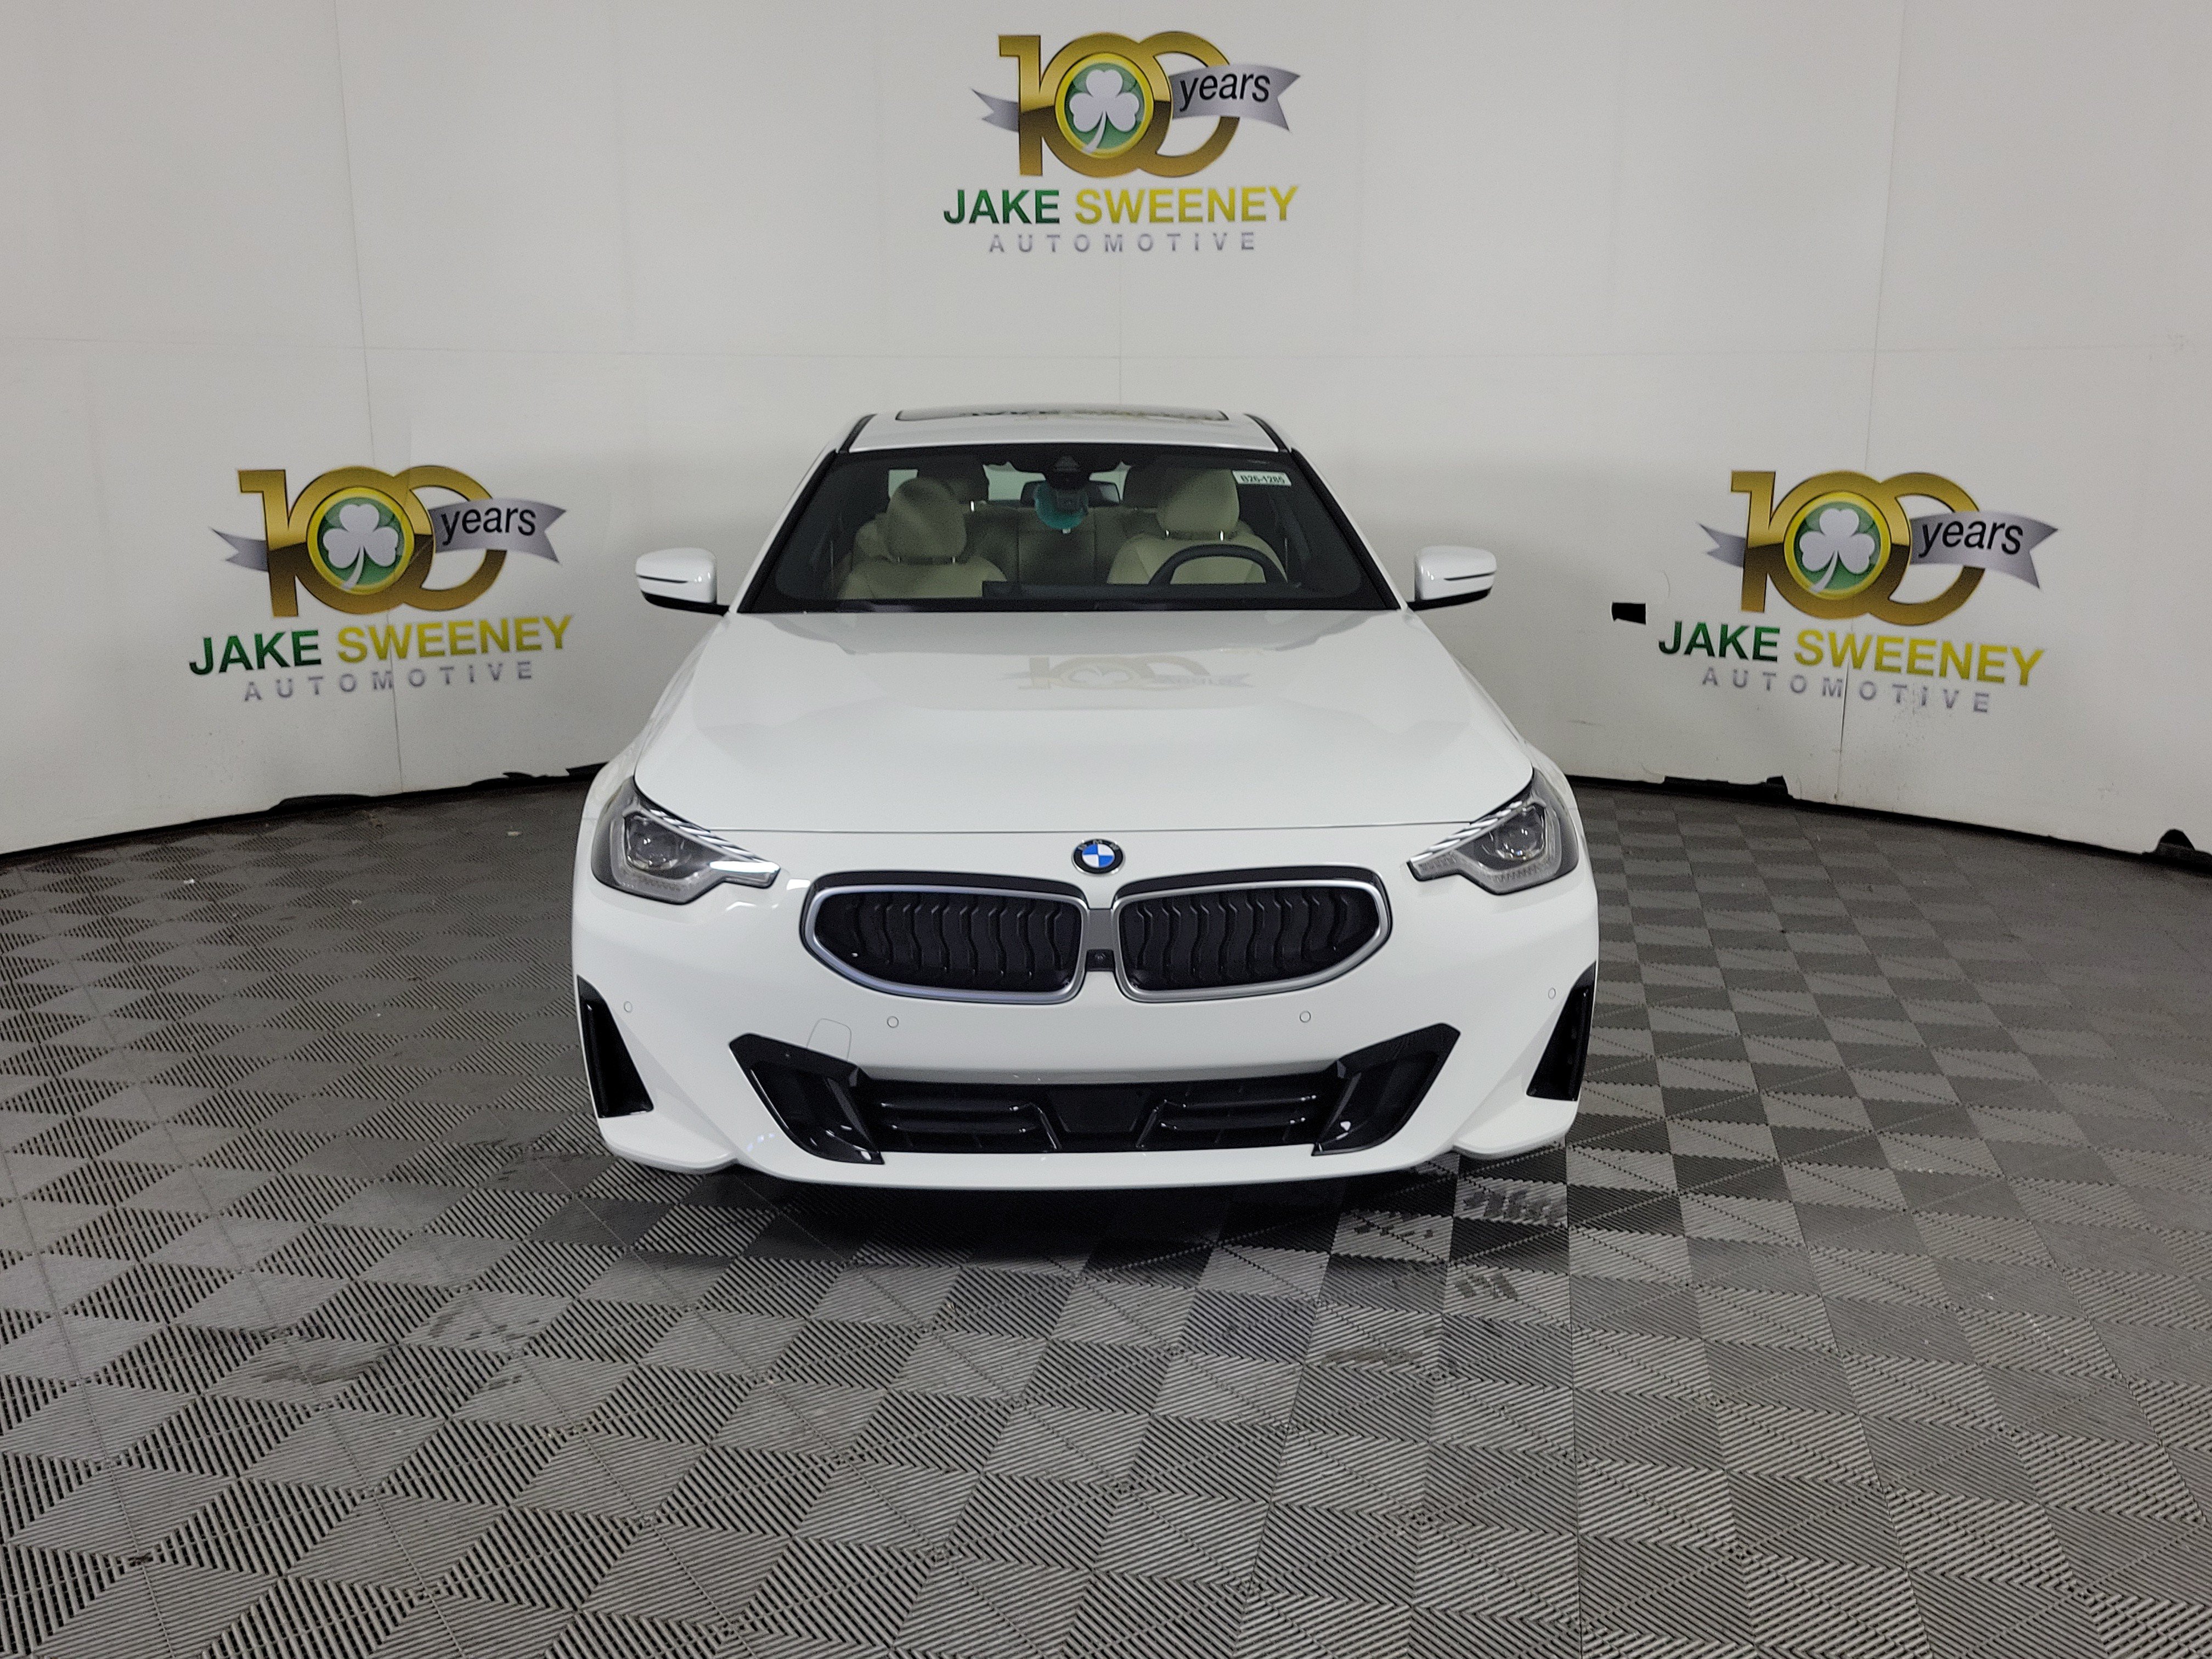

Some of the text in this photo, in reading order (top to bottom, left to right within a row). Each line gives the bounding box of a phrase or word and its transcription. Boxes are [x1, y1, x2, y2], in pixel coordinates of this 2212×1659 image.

[998, 31, 1271, 178] 100 years
[943, 185, 1299, 225] JAKE SWEENEY
[989, 231, 1255, 254] AUTOMOTIVE
[238, 465, 537, 618] 100 years
[1730, 470, 2024, 626] 100 years
[189, 614, 573, 676] JAKE SWEENEY
[1658, 620, 2045, 686] JAKE SWEENEY
[244, 662, 532, 703] AUTOMOTIVE
[1702, 666, 1990, 713] AUTOMOTIVE
